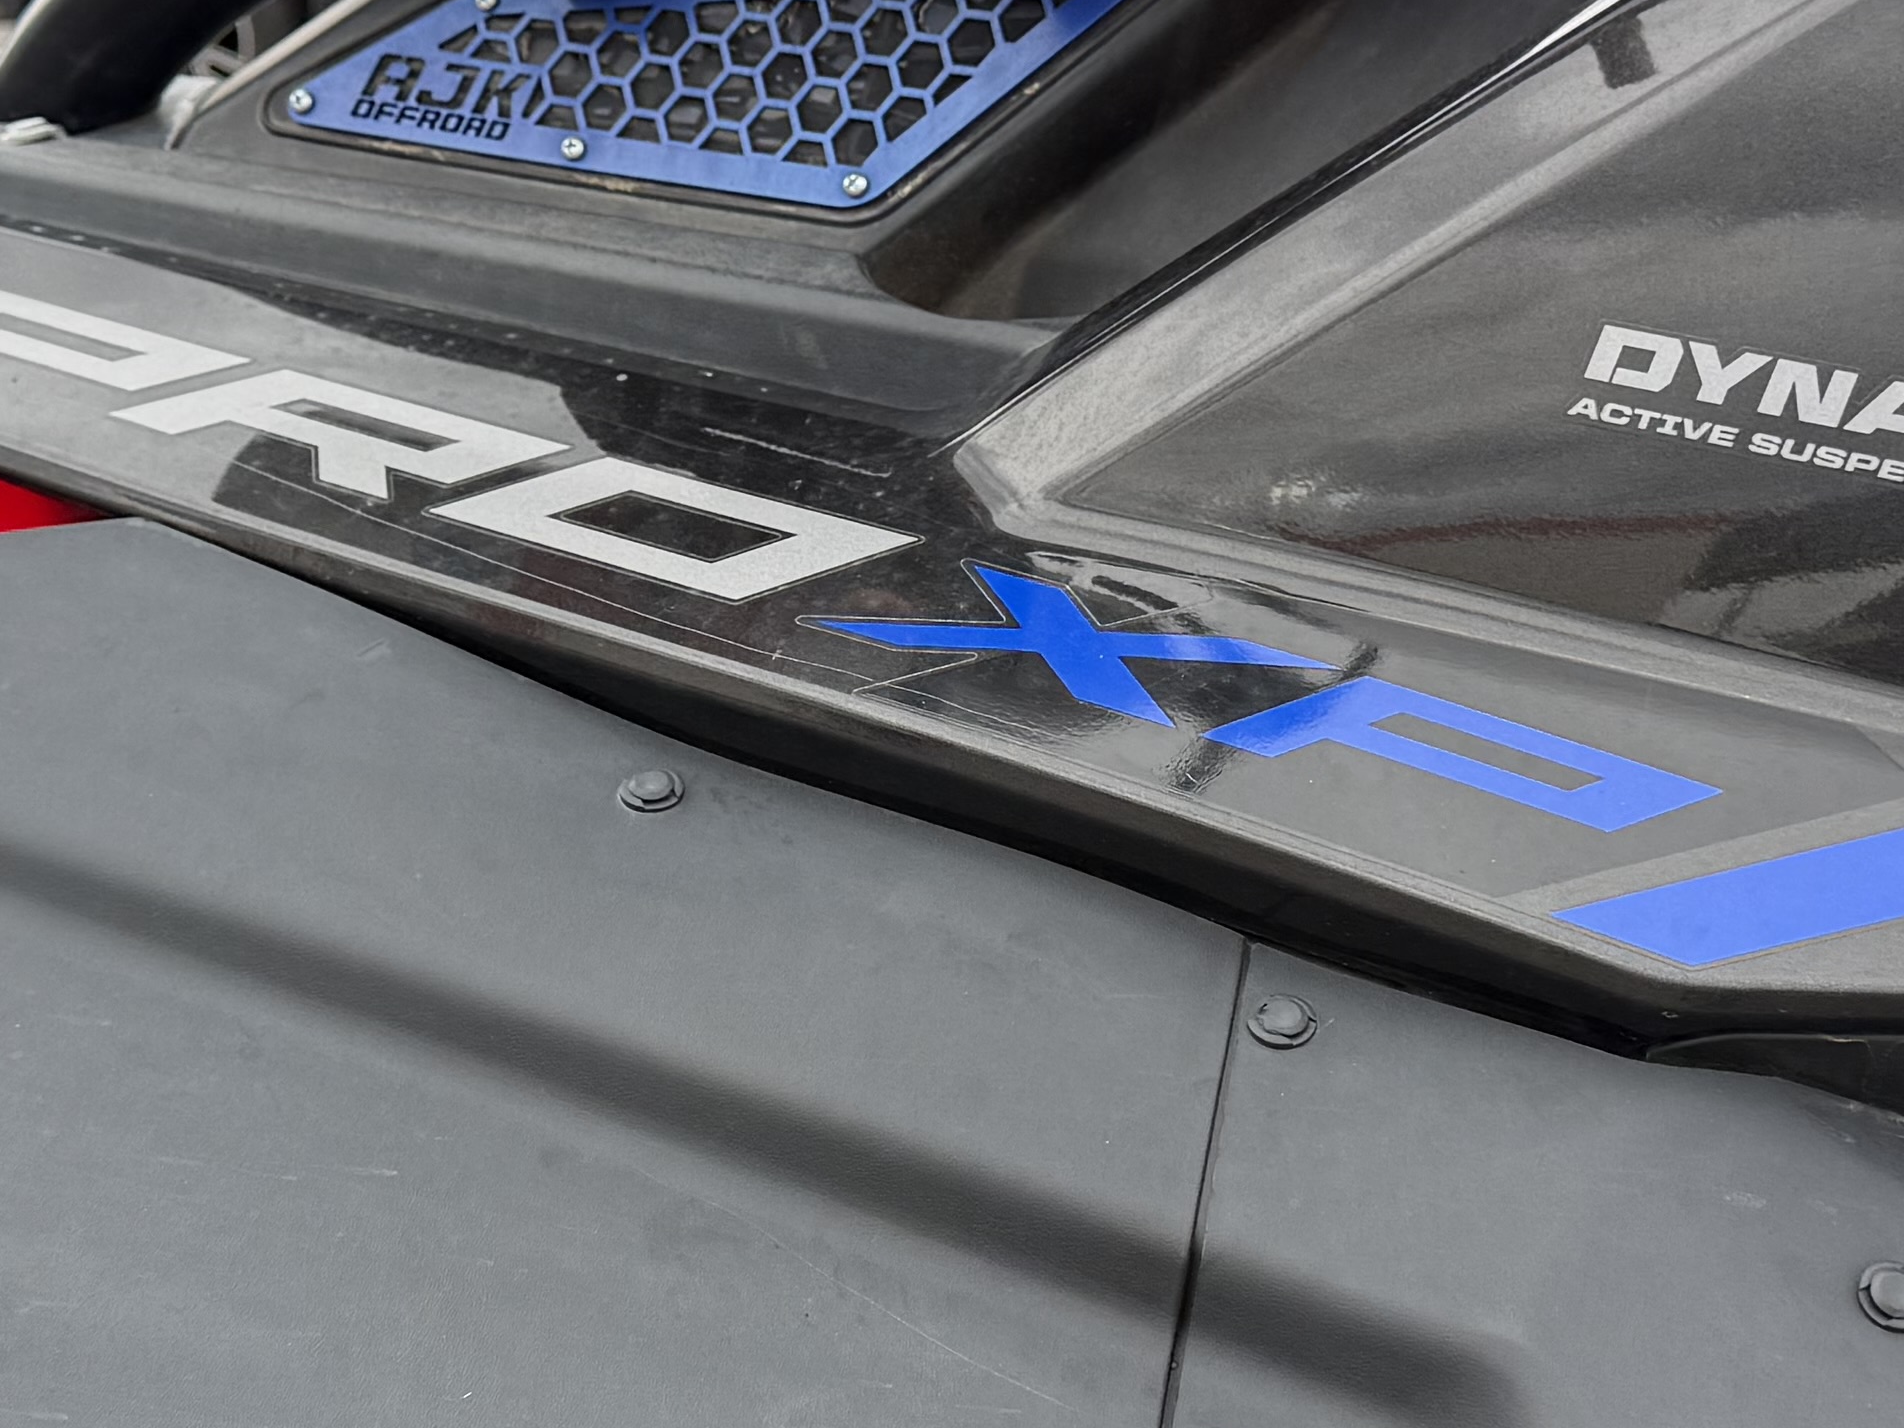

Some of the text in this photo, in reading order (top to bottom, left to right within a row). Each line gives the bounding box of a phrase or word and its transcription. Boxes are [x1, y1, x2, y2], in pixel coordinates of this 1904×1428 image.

[359, 52, 532, 120] AJK
[349, 98, 511, 141] OFFROAD
[1568, 397, 1736, 450] ACTIVE
[803, 557, 1723, 835] XP
